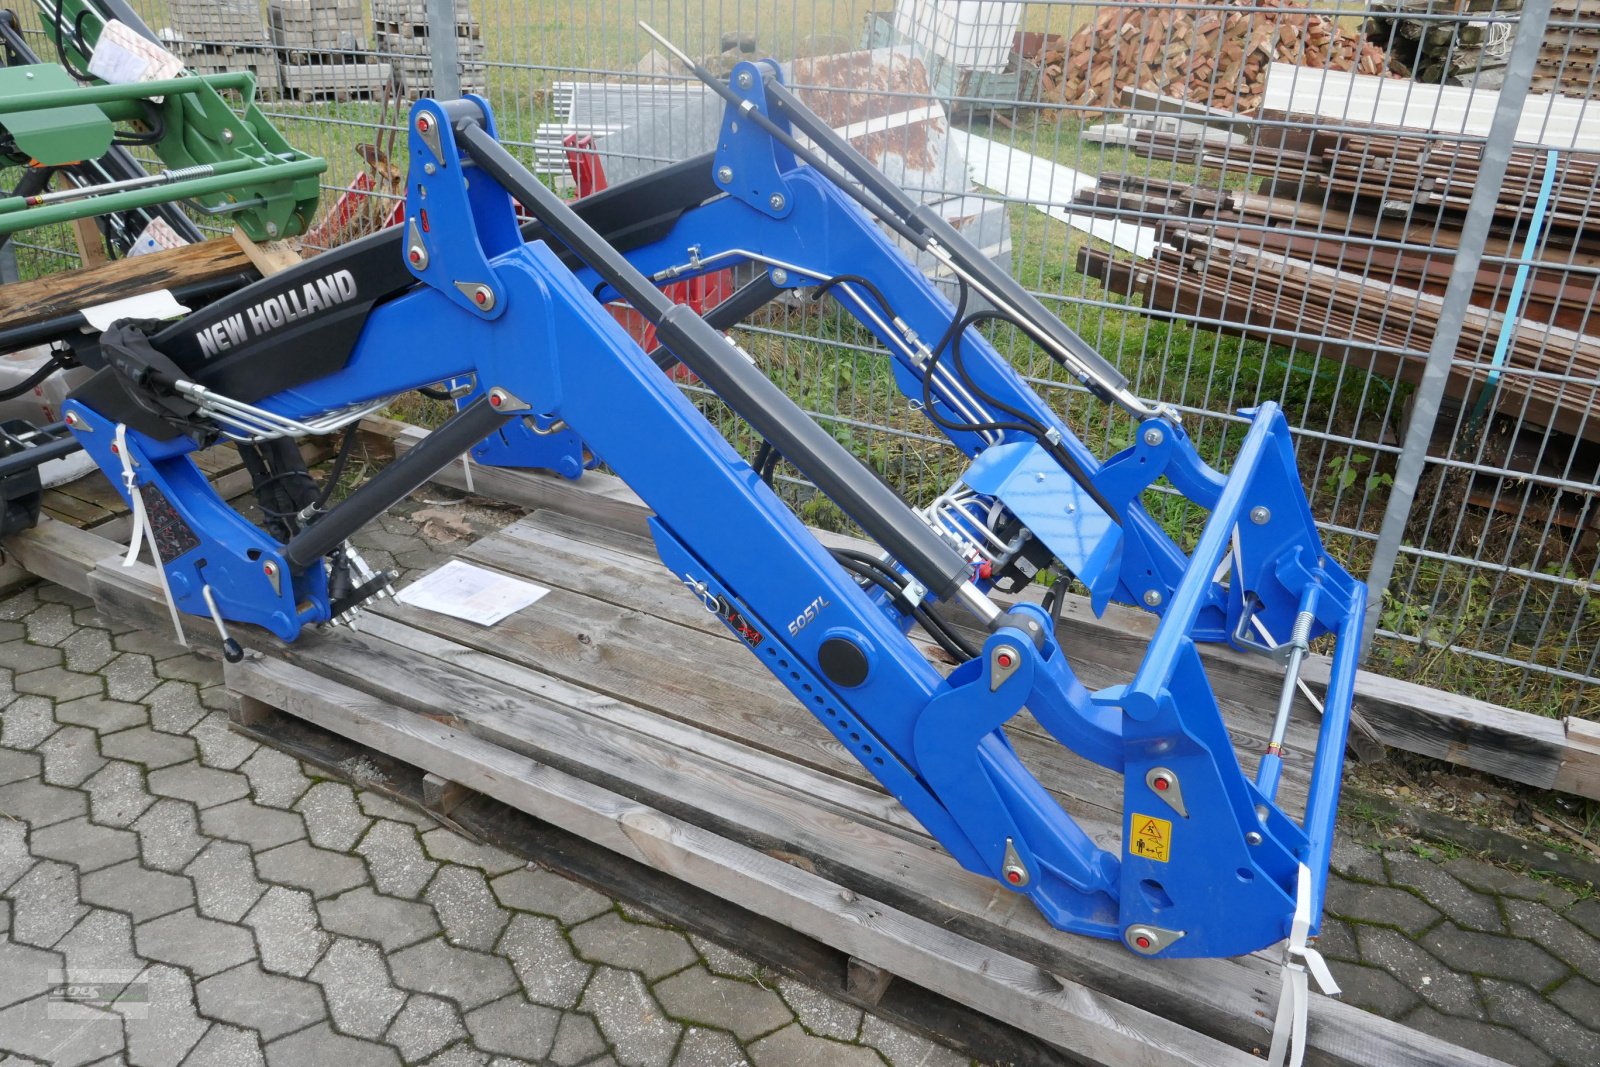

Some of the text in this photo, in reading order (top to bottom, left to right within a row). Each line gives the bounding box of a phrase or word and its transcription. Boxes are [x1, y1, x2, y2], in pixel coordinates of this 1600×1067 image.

[196, 269, 358, 359] NEW HOLLAND
[787, 596, 830, 637] 505TL
